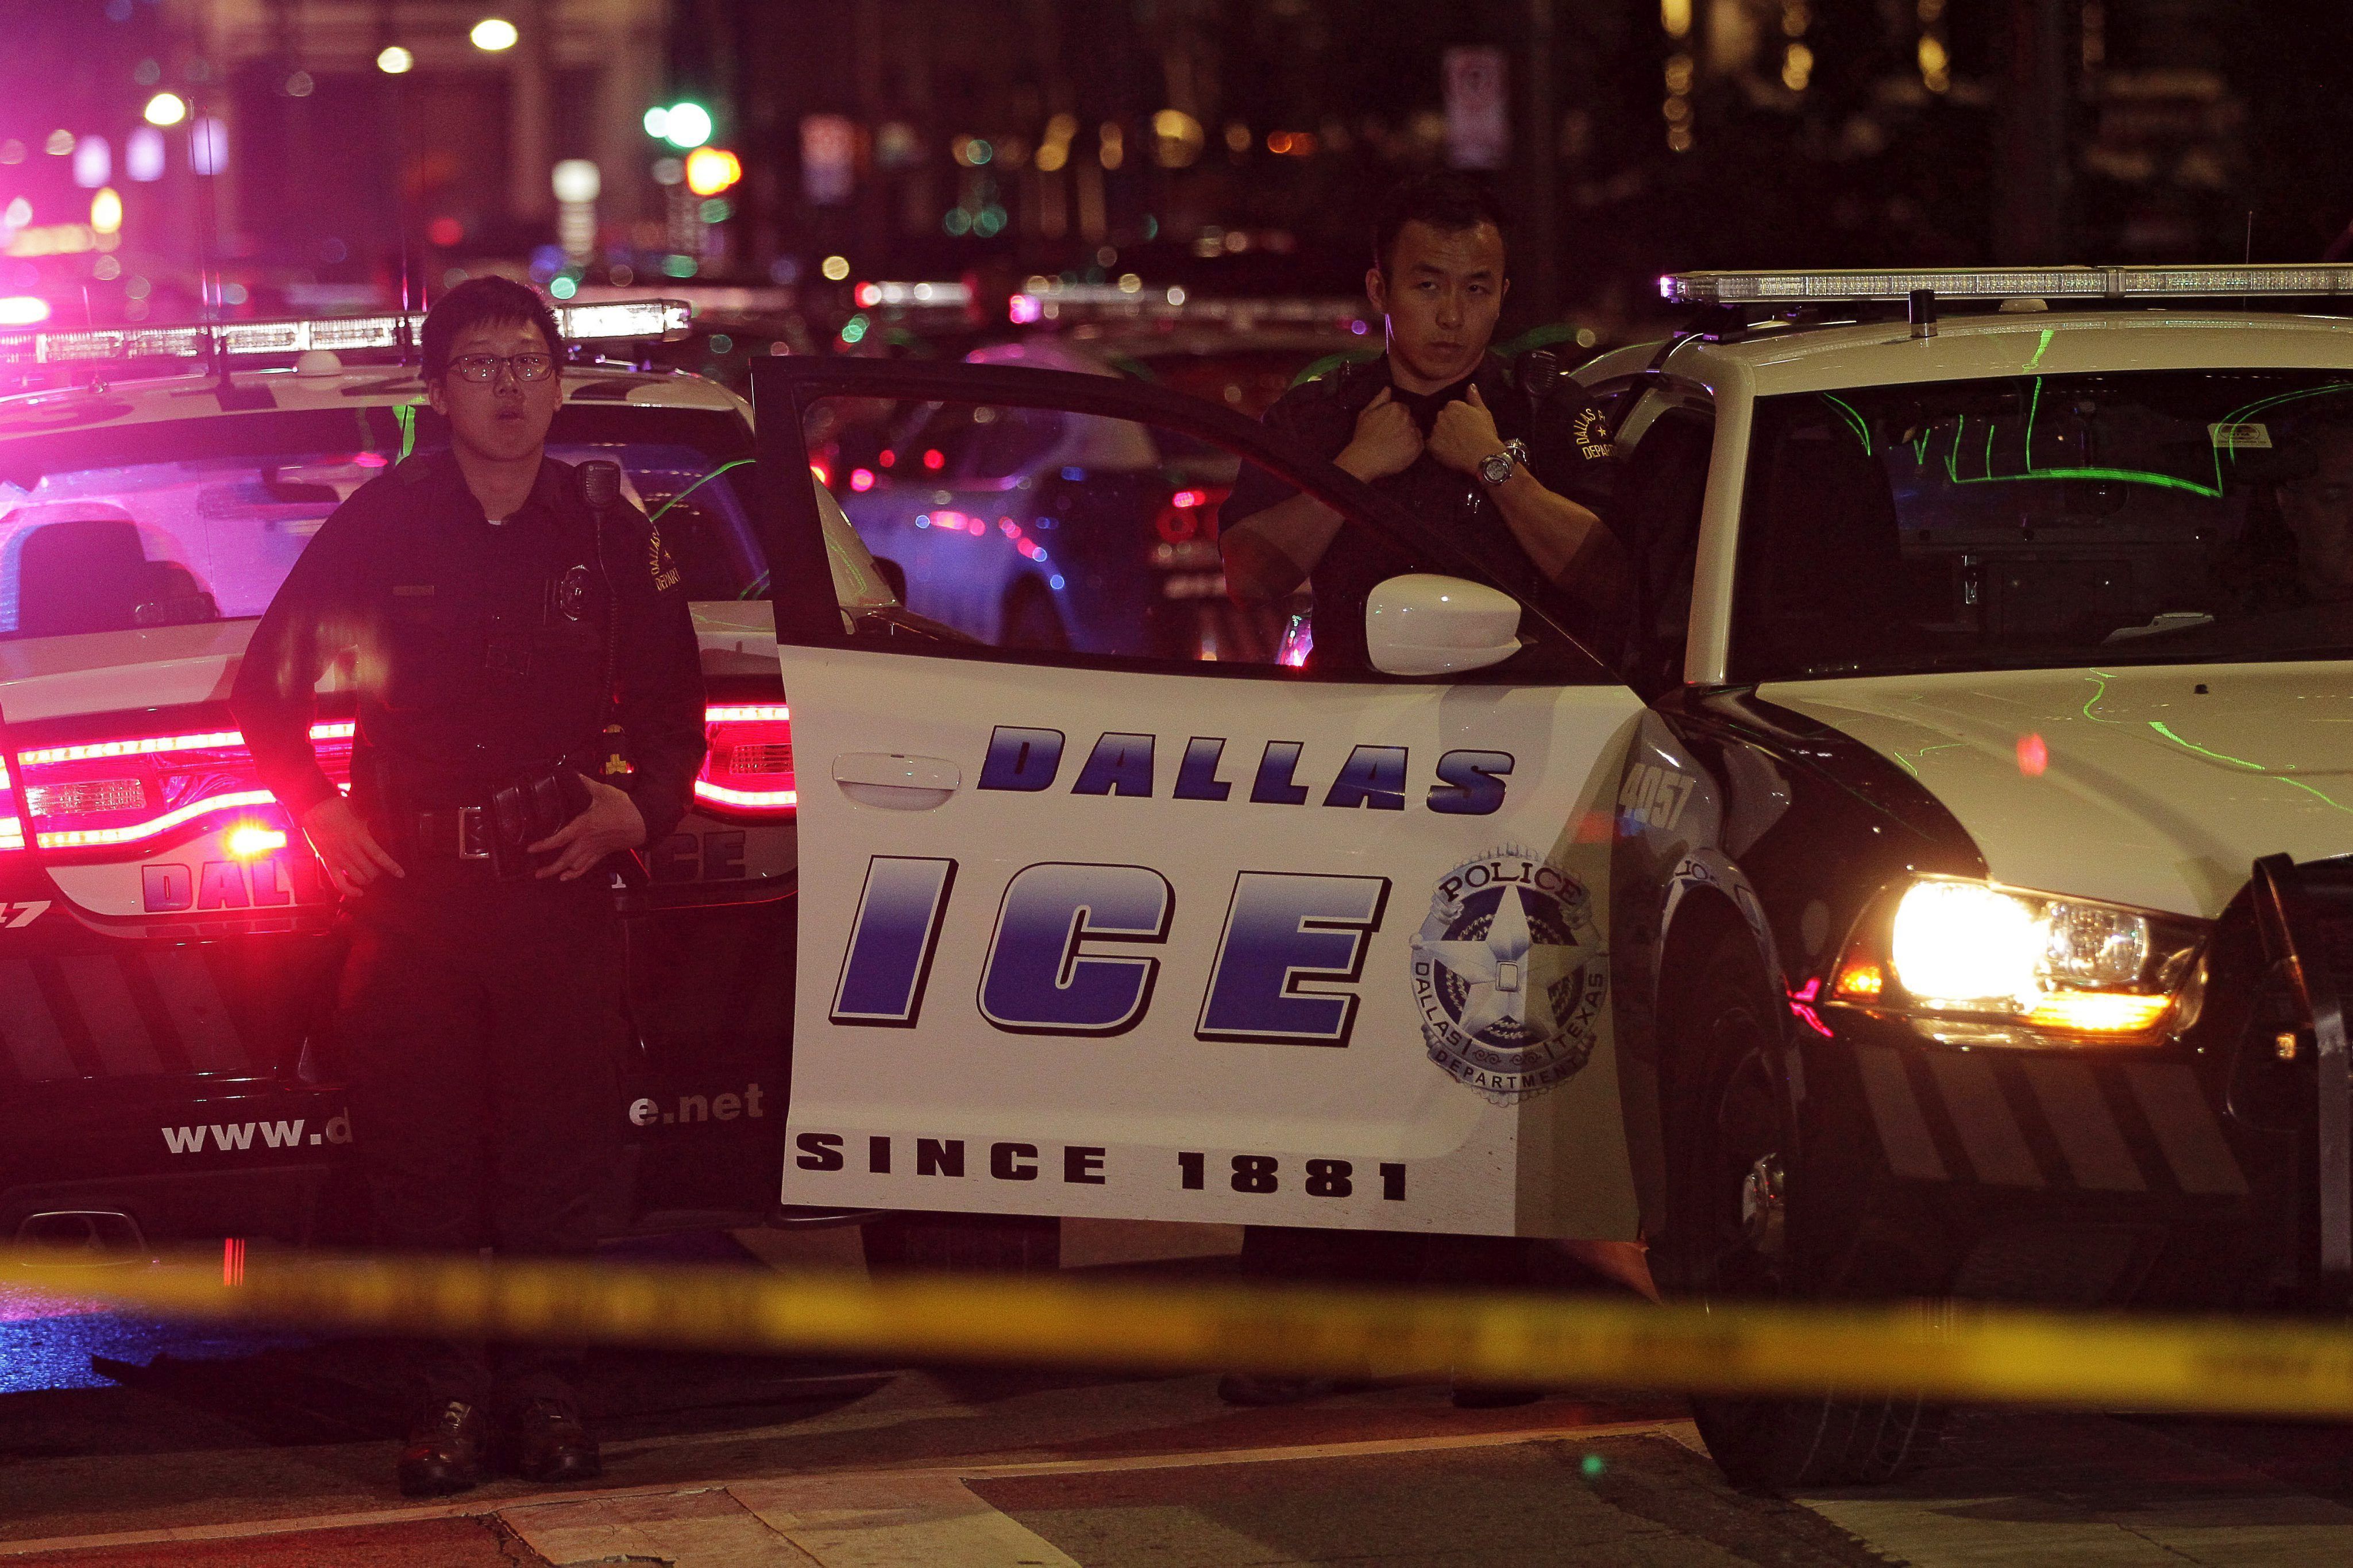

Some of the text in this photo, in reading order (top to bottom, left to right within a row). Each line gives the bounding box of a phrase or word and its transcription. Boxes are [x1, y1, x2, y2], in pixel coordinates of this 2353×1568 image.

[1573, 408, 1596, 445] DALLAS
[977, 725, 1515, 816] DALLAS
[1618, 762, 1696, 832] 4057
[1438, 862, 1582, 906] POLICE
[828, 854, 1392, 1048] ICE
[1415, 961, 1462, 1047] DALLAS
[1552, 973, 1603, 1049] TEXAS
[1436, 1049, 1577, 1088] DEPARTMENT
[161, 1083, 763, 1153] www.d e.net
[796, 1133, 1407, 1202] SINCE 1881
